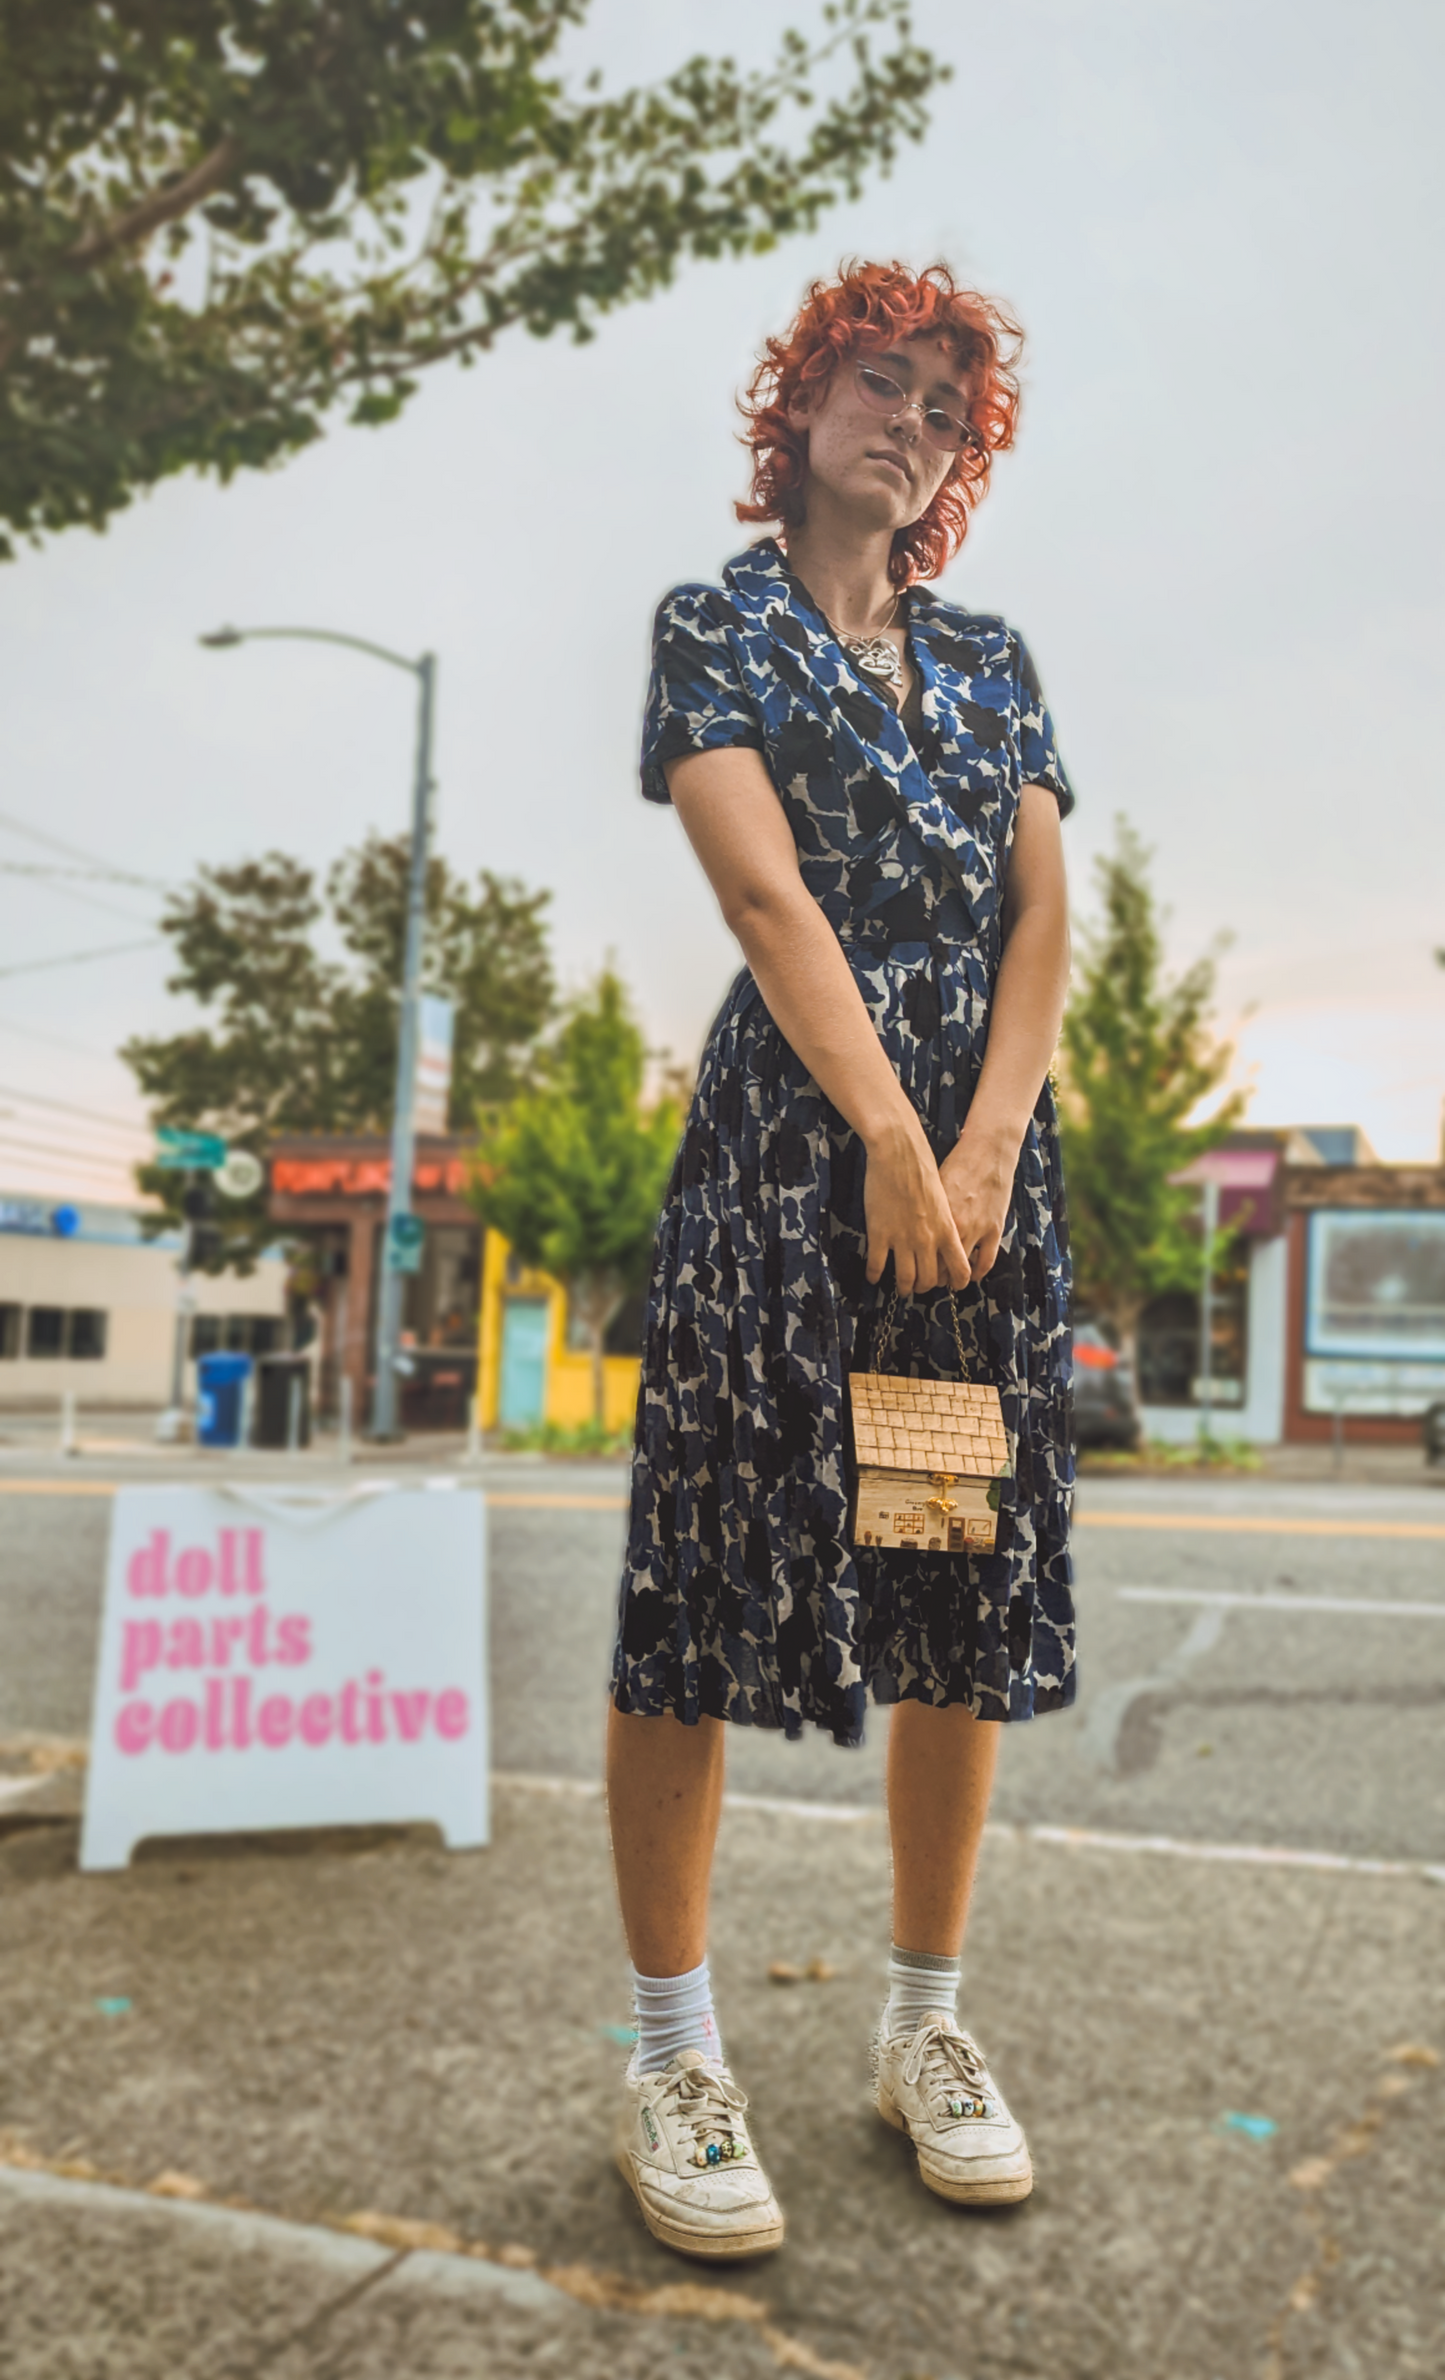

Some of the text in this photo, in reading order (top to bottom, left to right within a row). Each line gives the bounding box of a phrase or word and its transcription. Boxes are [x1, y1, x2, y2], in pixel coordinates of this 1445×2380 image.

[127, 1528, 264, 1598] doll
[120, 1604, 311, 1692] parts
[114, 1669, 469, 1756] collective
